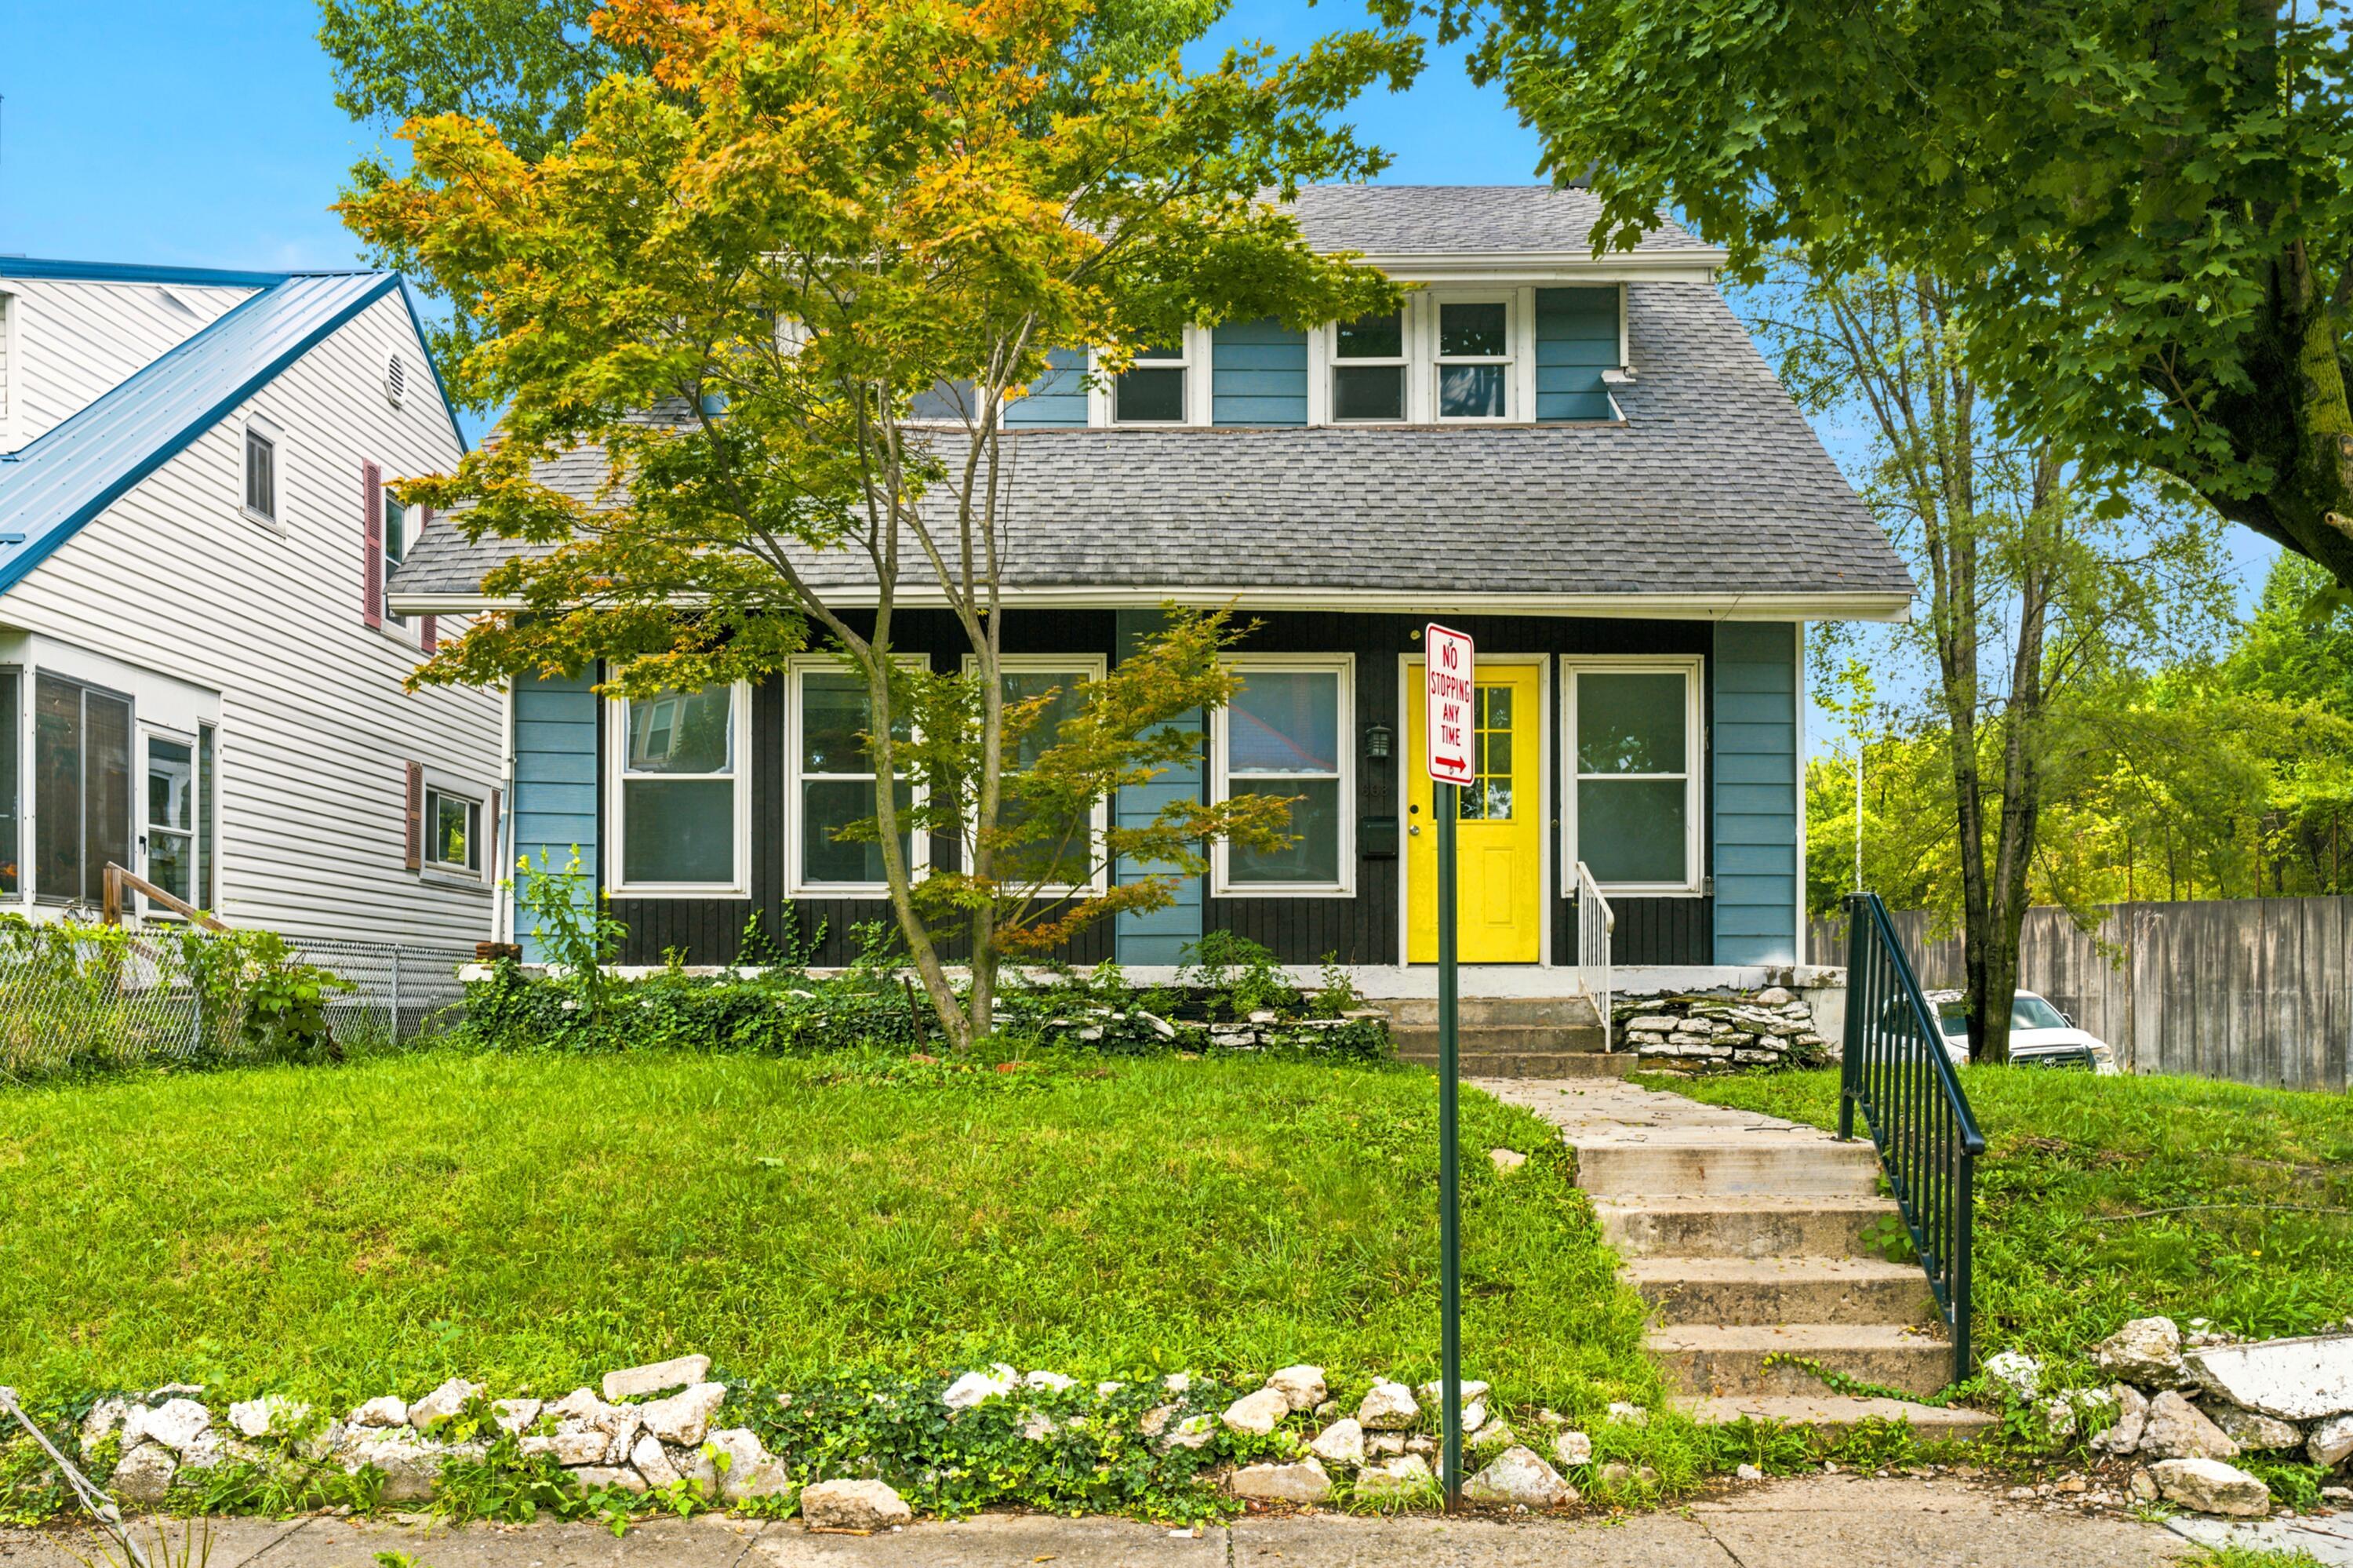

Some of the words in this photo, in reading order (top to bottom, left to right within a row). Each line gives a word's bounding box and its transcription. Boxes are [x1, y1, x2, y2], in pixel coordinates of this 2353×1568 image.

[1442, 644, 1457, 670] NO
[1431, 671, 1470, 703] STOPPING
[1442, 703, 1460, 723] ANY
[1441, 725, 1460, 747] TIME
